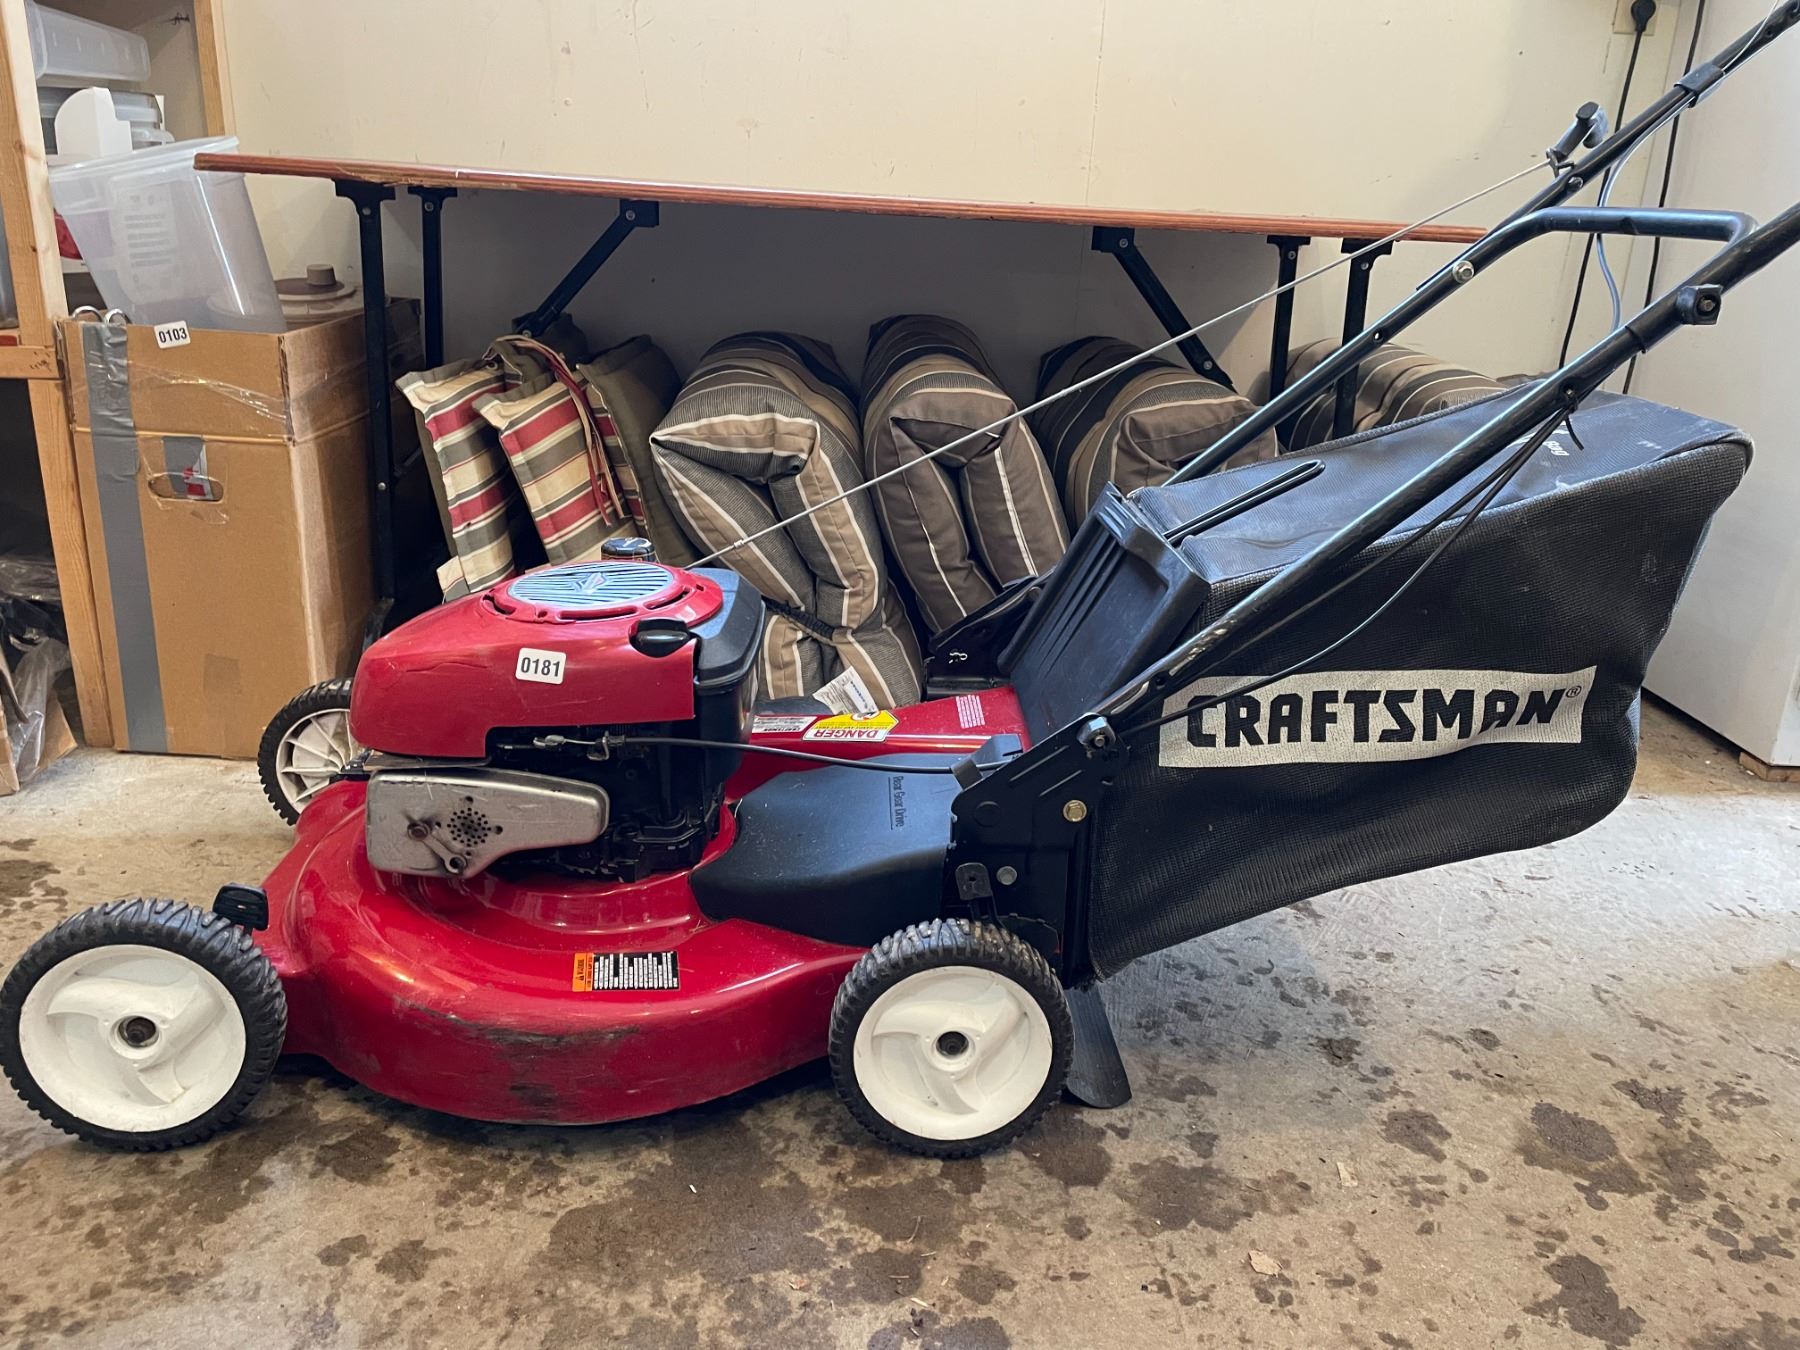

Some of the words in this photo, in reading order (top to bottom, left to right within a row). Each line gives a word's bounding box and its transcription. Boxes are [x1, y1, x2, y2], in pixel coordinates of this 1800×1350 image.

[158, 327, 187, 343] 0103
[520, 656, 561, 677] 0181
[813, 729, 879, 739] DANGER
[892, 775, 904, 791] Rear
[894, 791, 906, 808] Gear
[895, 808, 908, 828] Drive
